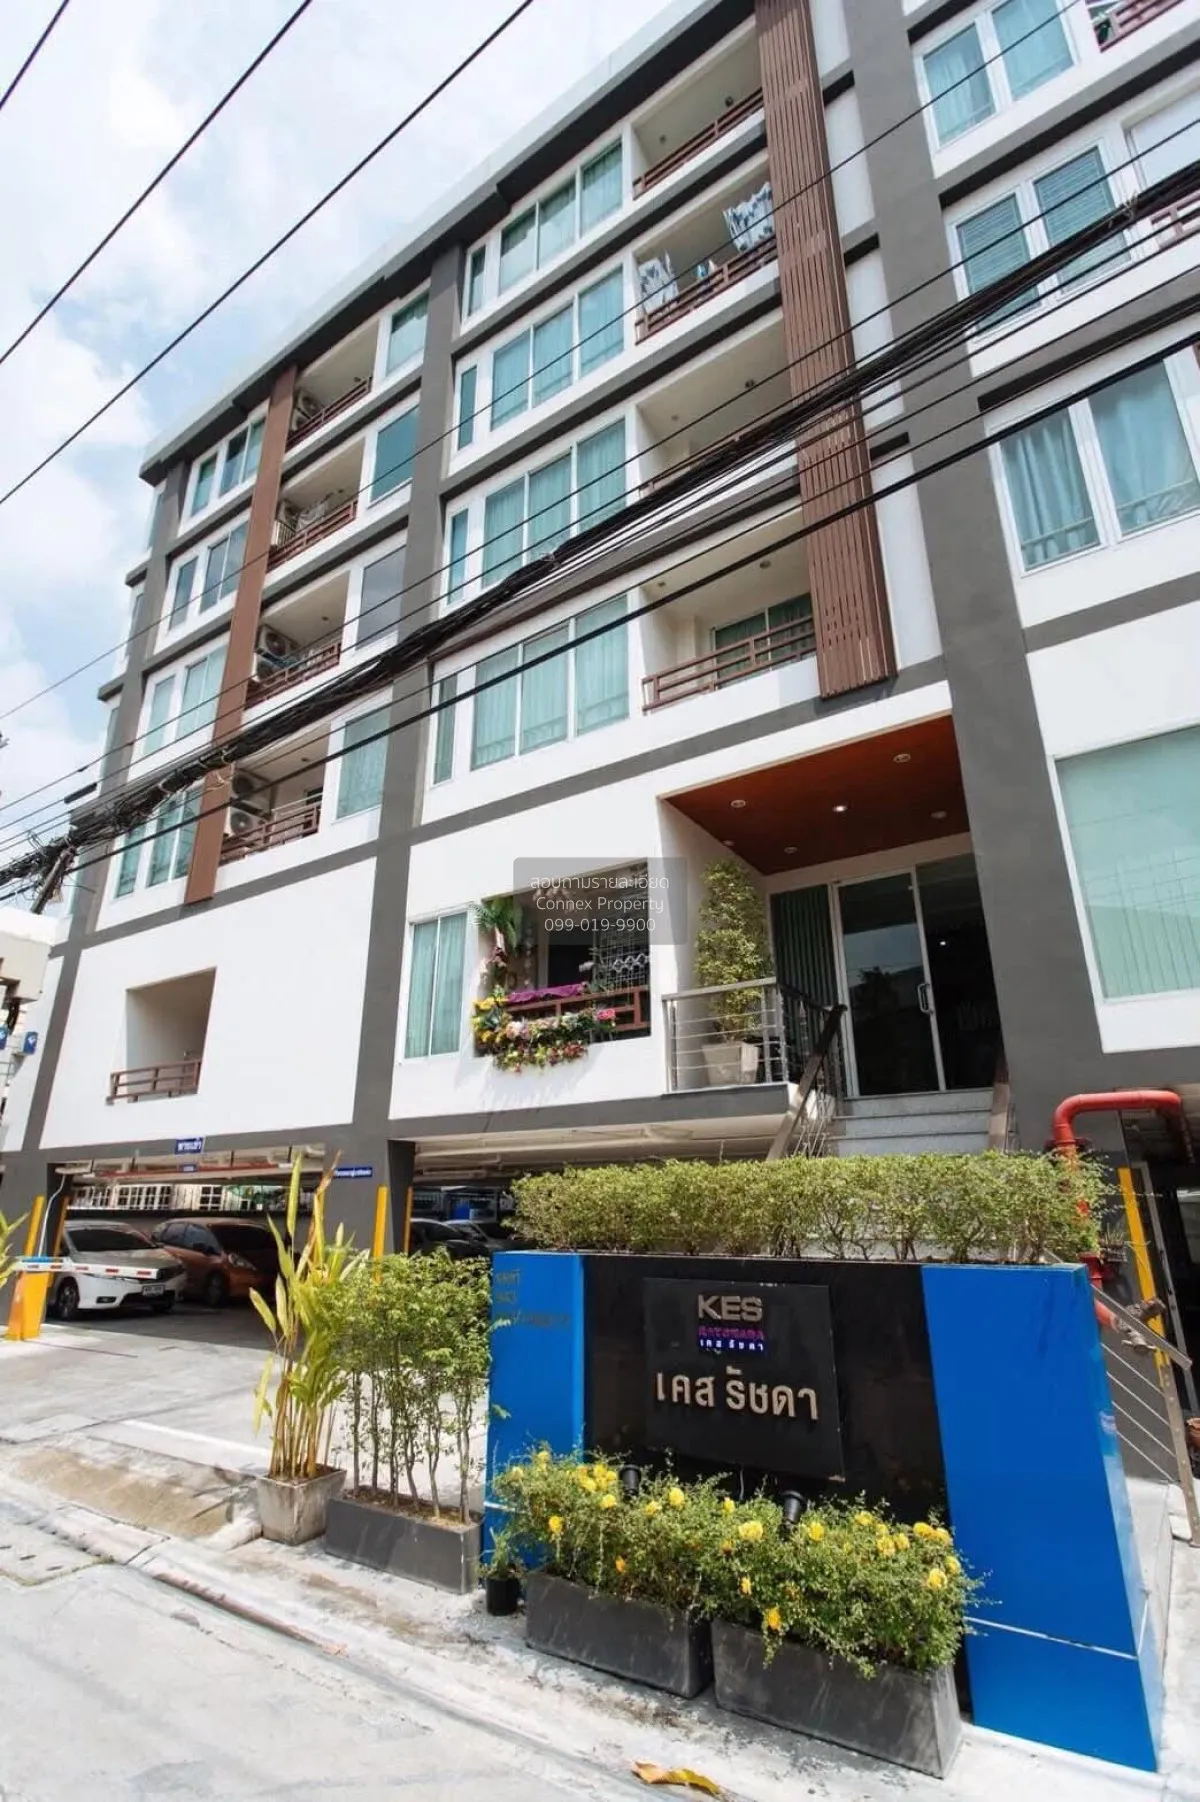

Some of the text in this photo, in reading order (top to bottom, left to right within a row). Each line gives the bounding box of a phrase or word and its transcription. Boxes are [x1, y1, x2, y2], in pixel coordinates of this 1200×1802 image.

[697, 1294, 763, 1323] KES
[656, 1364, 818, 1420] เคส รัชดา
